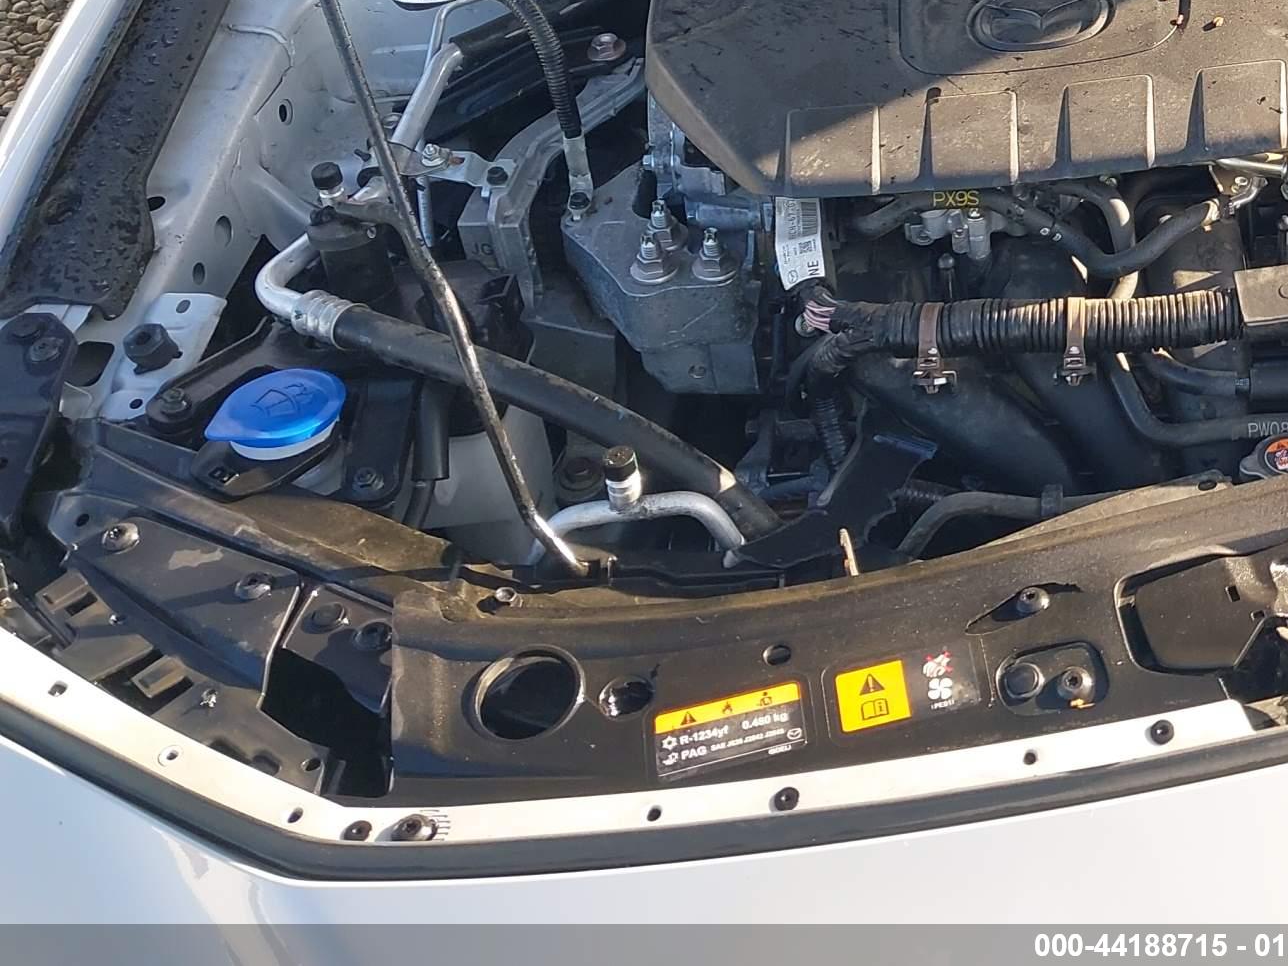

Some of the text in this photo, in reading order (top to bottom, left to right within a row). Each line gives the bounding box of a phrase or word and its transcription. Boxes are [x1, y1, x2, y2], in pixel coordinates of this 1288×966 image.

[932, 190, 980, 207] PX9S
[807, 260, 820, 276] NE
[681, 745, 708, 760] PAG
